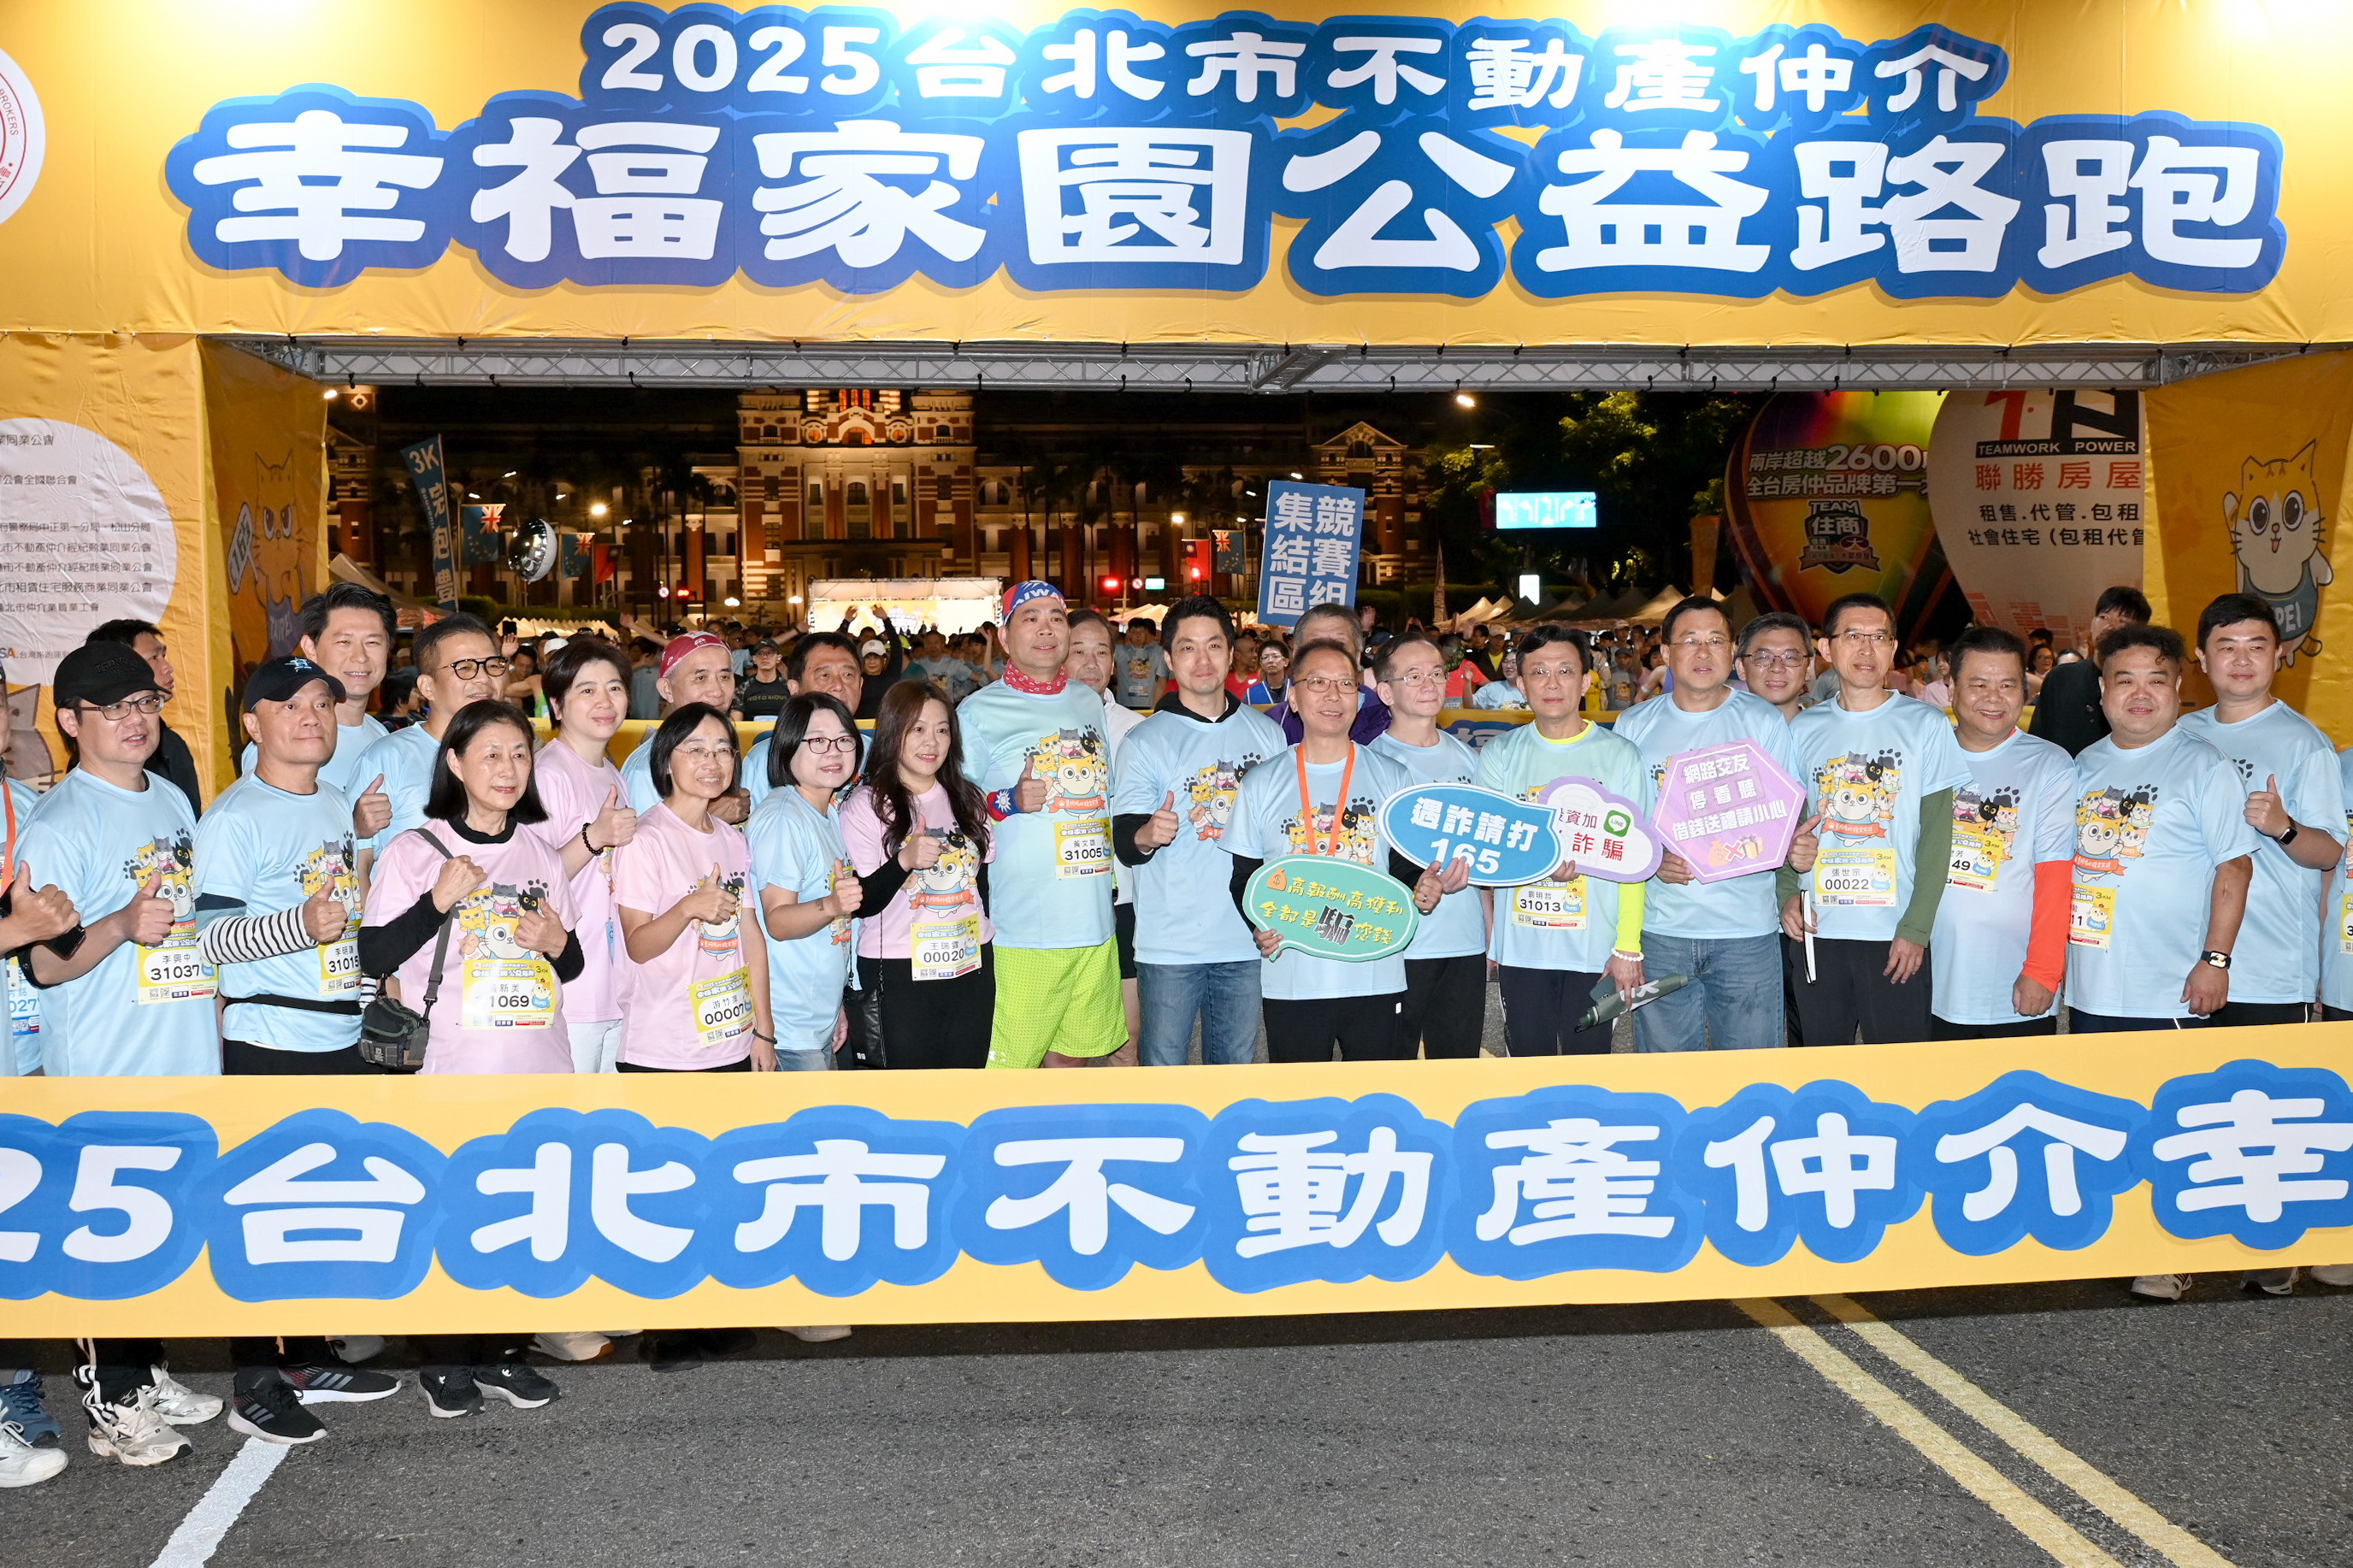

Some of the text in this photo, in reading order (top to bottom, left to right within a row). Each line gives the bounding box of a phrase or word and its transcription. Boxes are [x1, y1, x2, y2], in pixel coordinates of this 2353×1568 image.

[602, 22, 1993, 114] 2025台北市不動產仲介
[193, 109, 2265, 274] 幸福家園公益路跑
[1979, 441, 2137, 456] TEAMWORK POWER
[1975, 462, 2141, 491] 聯勝房屋
[1809, 501, 1859, 515] TEAM
[1813, 516, 1861, 535] 住商
[1968, 528, 2040, 545] 社會住宅
[1267, 491, 1313, 616] 集結區
[1683, 753, 1750, 785] 網路交友
[1690, 779, 1757, 811] 停看聽
[1410, 796, 1539, 853] 遇詐請打
[1610, 818, 1624, 828] LINE
[1672, 799, 1789, 842] 借錢送禮請小心
[1064, 847, 1102, 860] 31005
[1429, 838, 1501, 875] 165
[1951, 859, 1970, 870] 49
[1825, 879, 1869, 890] 00022
[1287, 875, 1405, 917] 高報酬高獲利
[1519, 899, 1560, 911] 31013
[1259, 900, 1394, 946] 全都是騙您錢
[328, 955, 359, 973] 31015
[923, 948, 964, 963] 00020
[150, 964, 199, 981] 31037
[9, 998, 37, 1013] 027
[705, 1003, 744, 1025] 00007
